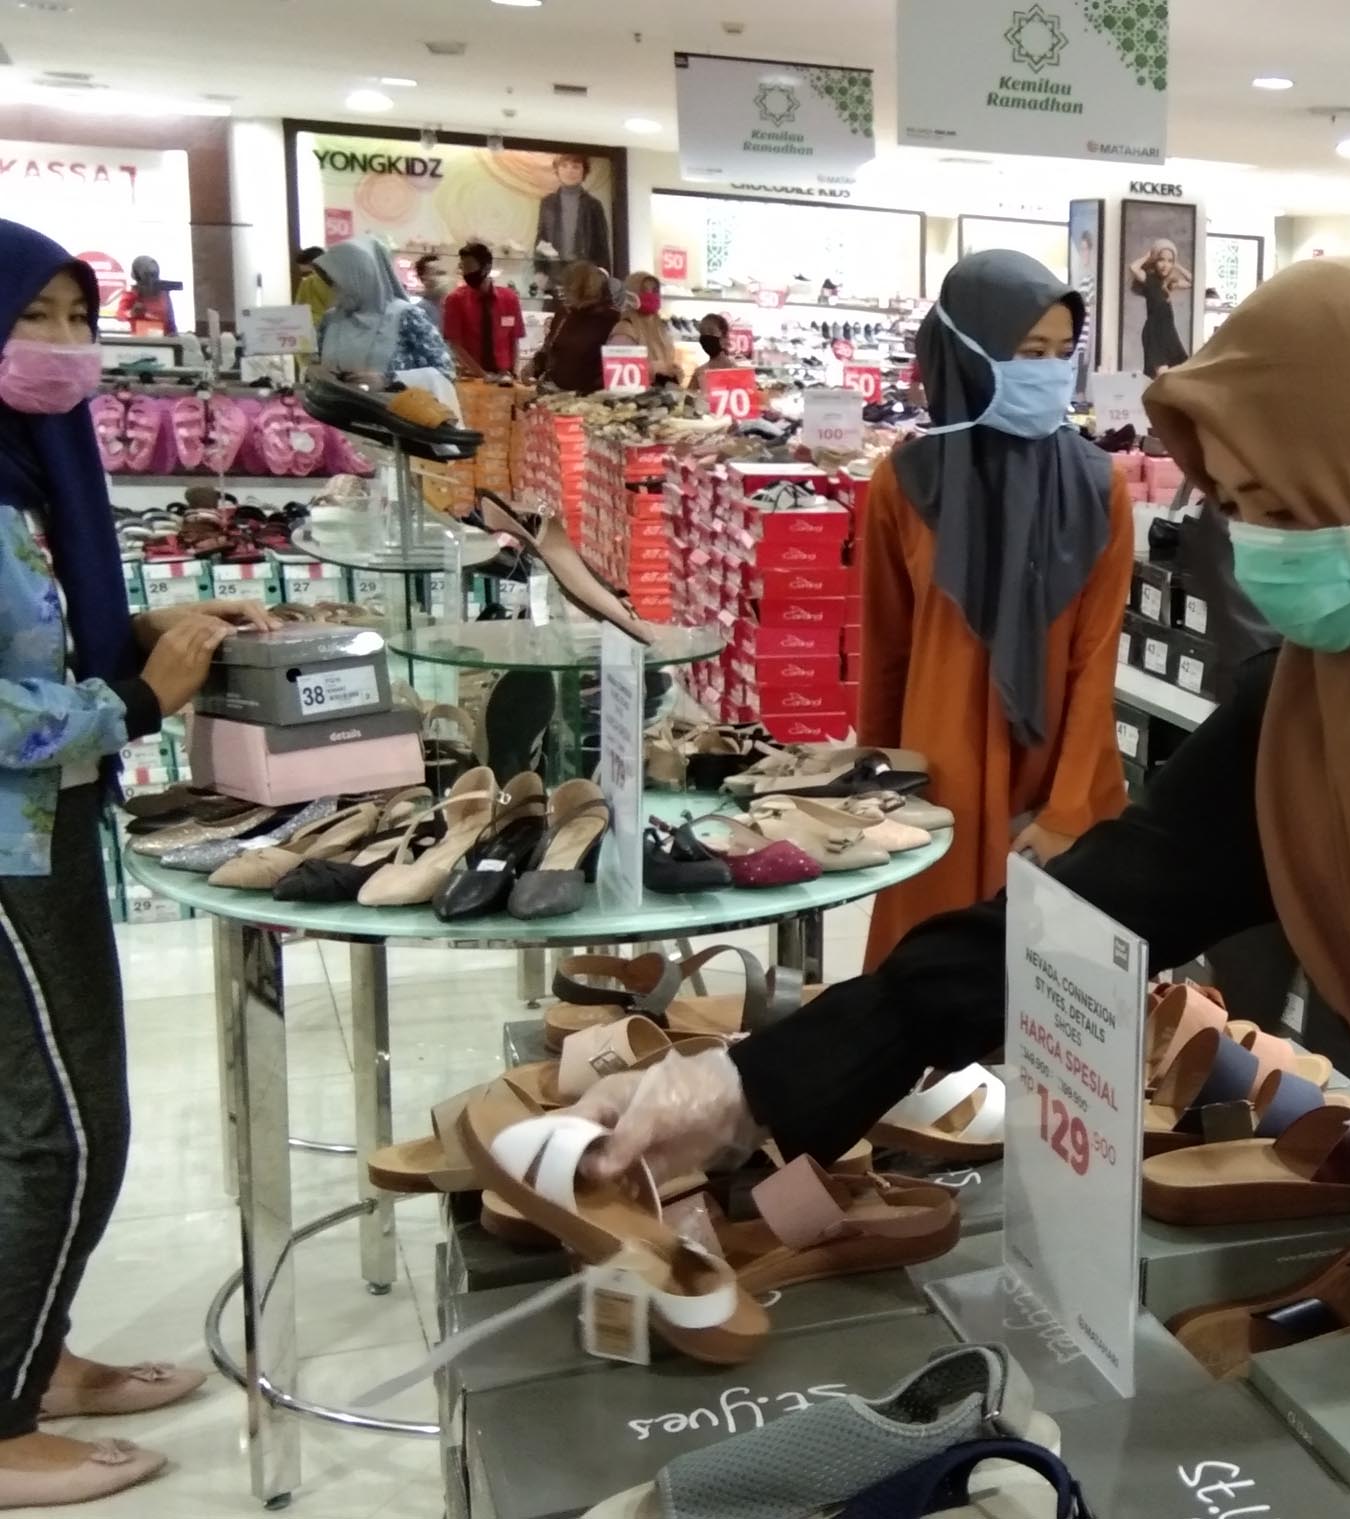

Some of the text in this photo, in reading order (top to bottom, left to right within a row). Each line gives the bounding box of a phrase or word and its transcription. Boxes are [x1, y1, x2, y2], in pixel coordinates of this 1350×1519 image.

[998, 76, 1073, 96] Kemilau
[986, 92, 1084, 115] Ramadhan
[750, 128, 805, 143] Kemilau
[742, 141, 814, 157] Ramadhan
[1099, 145, 1161, 158] MATAHARI
[313, 149, 444, 179] YONGKIDZ
[1129, 180, 1184, 197] KICKERS
[662, 253, 685, 270] 50
[605, 363, 642, 390] 70
[711, 387, 751, 419] 70
[150, 582, 168, 593] 28
[218, 584, 237, 595] 25
[293, 581, 311, 592] 27
[359, 582, 377, 592] 29
[500, 583, 516, 593] 27
[302, 685, 326, 706] 38
[329, 728, 362, 742] details
[1035, 975, 1046, 994] ST
[1069, 1004, 1105, 1044] DETAILS
[1062, 976, 1117, 1030] CONNEXION
[1054, 1013, 1082, 1047] SHOES
[1019, 1010, 1063, 1063] HARGA
[1065, 1049, 1119, 1112] SPESIAL
